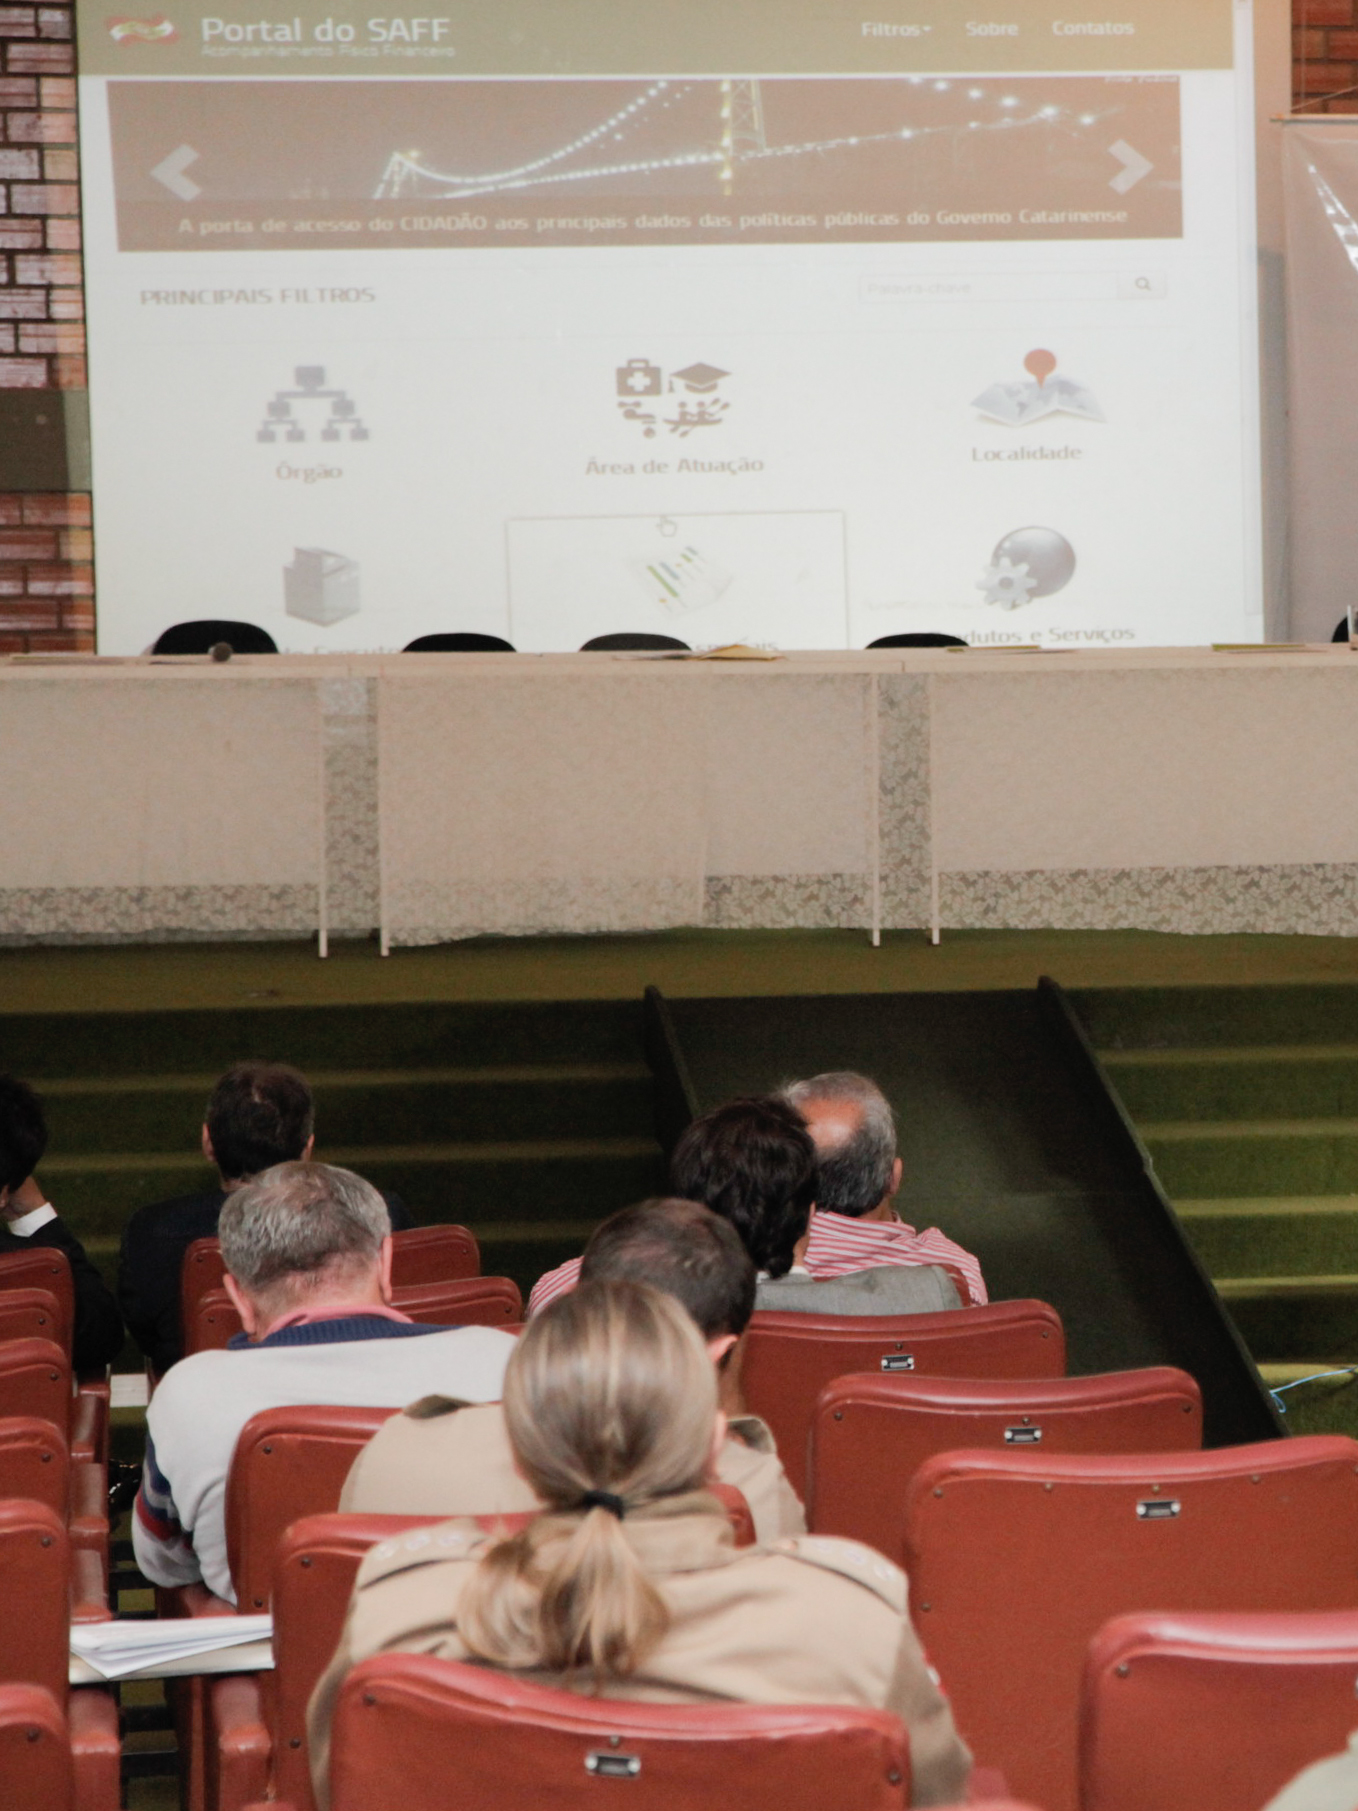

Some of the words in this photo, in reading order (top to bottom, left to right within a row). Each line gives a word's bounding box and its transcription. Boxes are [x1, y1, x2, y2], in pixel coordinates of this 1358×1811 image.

[201, 16, 302, 42] Portal
[314, 17, 355, 42] do
[367, 17, 451, 42] SAFF
[861, 21, 921, 37] Filtros
[965, 20, 1019, 37] Sobre
[1052, 19, 1135, 36] Contatos
[179, 218, 193, 233] A
[200, 218, 254, 236] porta
[261, 217, 287, 232] de
[293, 219, 361, 232] acesso
[368, 216, 394, 232] do
[399, 212, 487, 231] CIDADÃO
[495, 216, 529, 230] aos
[536, 214, 627, 233] principais
[635, 213, 691, 229] dados
[699, 212, 732, 228] das
[739, 211, 817, 230] políticas
[824, 211, 900, 229] públicas
[906, 209, 931, 225] do
[936, 209, 1012, 225] Governo
[1018, 207, 1128, 224] Catarinense
[140, 288, 272, 305] PRINCIPAIS
[280, 286, 376, 303] FILTROS
[971, 445, 1083, 462] Localidade
[275, 460, 343, 484] Órgão
[585, 456, 635, 475] Área
[642, 459, 669, 475] de
[677, 456, 764, 476] Atuação
[1030, 631, 1043, 643] e
[1049, 625, 1136, 645] Serviços
